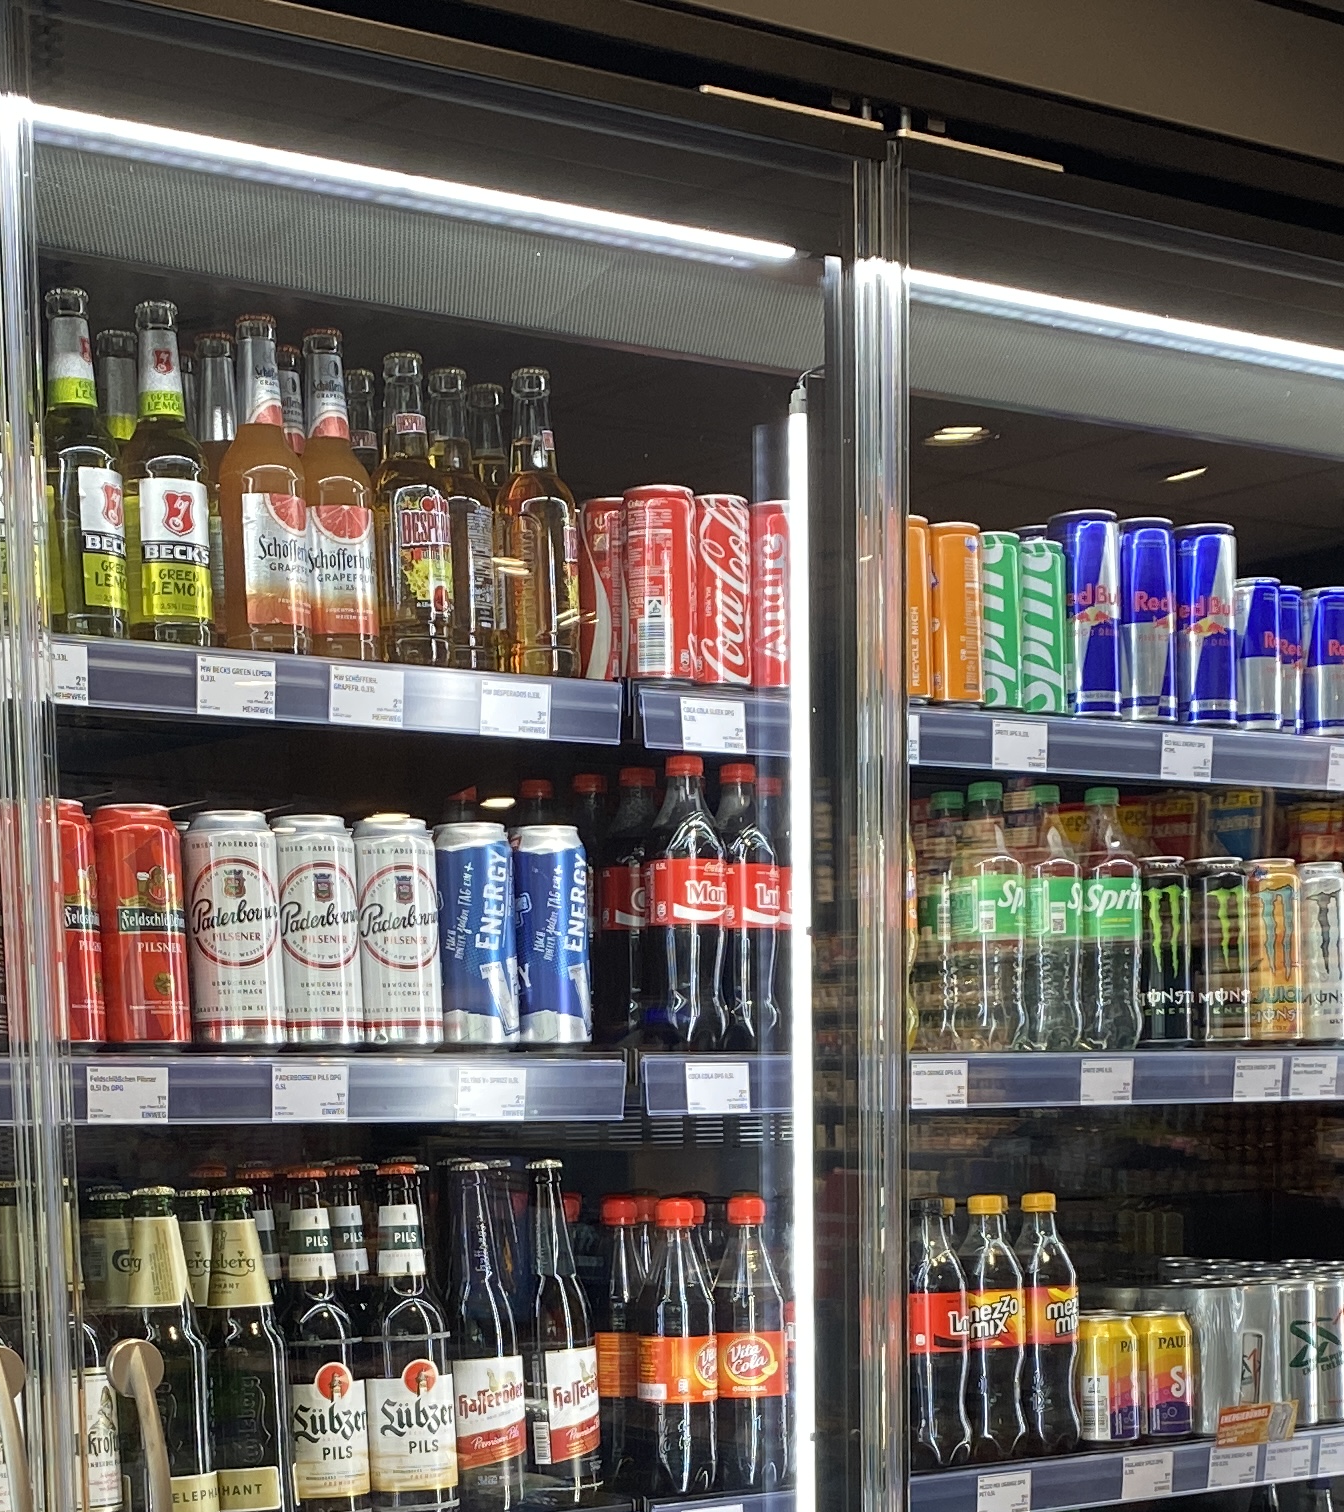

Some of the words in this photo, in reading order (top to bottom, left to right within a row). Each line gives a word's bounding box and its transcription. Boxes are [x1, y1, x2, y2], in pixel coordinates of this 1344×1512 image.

[158, 569, 200, 584] GREEN
[910, 606, 921, 634] MICH
[910, 635, 922, 688] RECYCLE
[475, 852, 510, 950] ENERGY
[564, 853, 588, 953] ENERGY
[212, 931, 261, 942] PILSENER
[301, 933, 348, 944] PILSENER
[136, 941, 183, 954] PILSNER
[305, 1236, 329, 1247] PILS
[393, 1231, 418, 1244] PILS
[970, 1314, 1007, 1339] mix
[730, 1343, 762, 1357] Vita
[1157, 1336, 1189, 1350] PAUL
[729, 1354, 768, 1374] Cola
[381, 1402, 455, 1441] Lübzer
[322, 1447, 353, 1461] PILS
[408, 1440, 440, 1454] PILS
